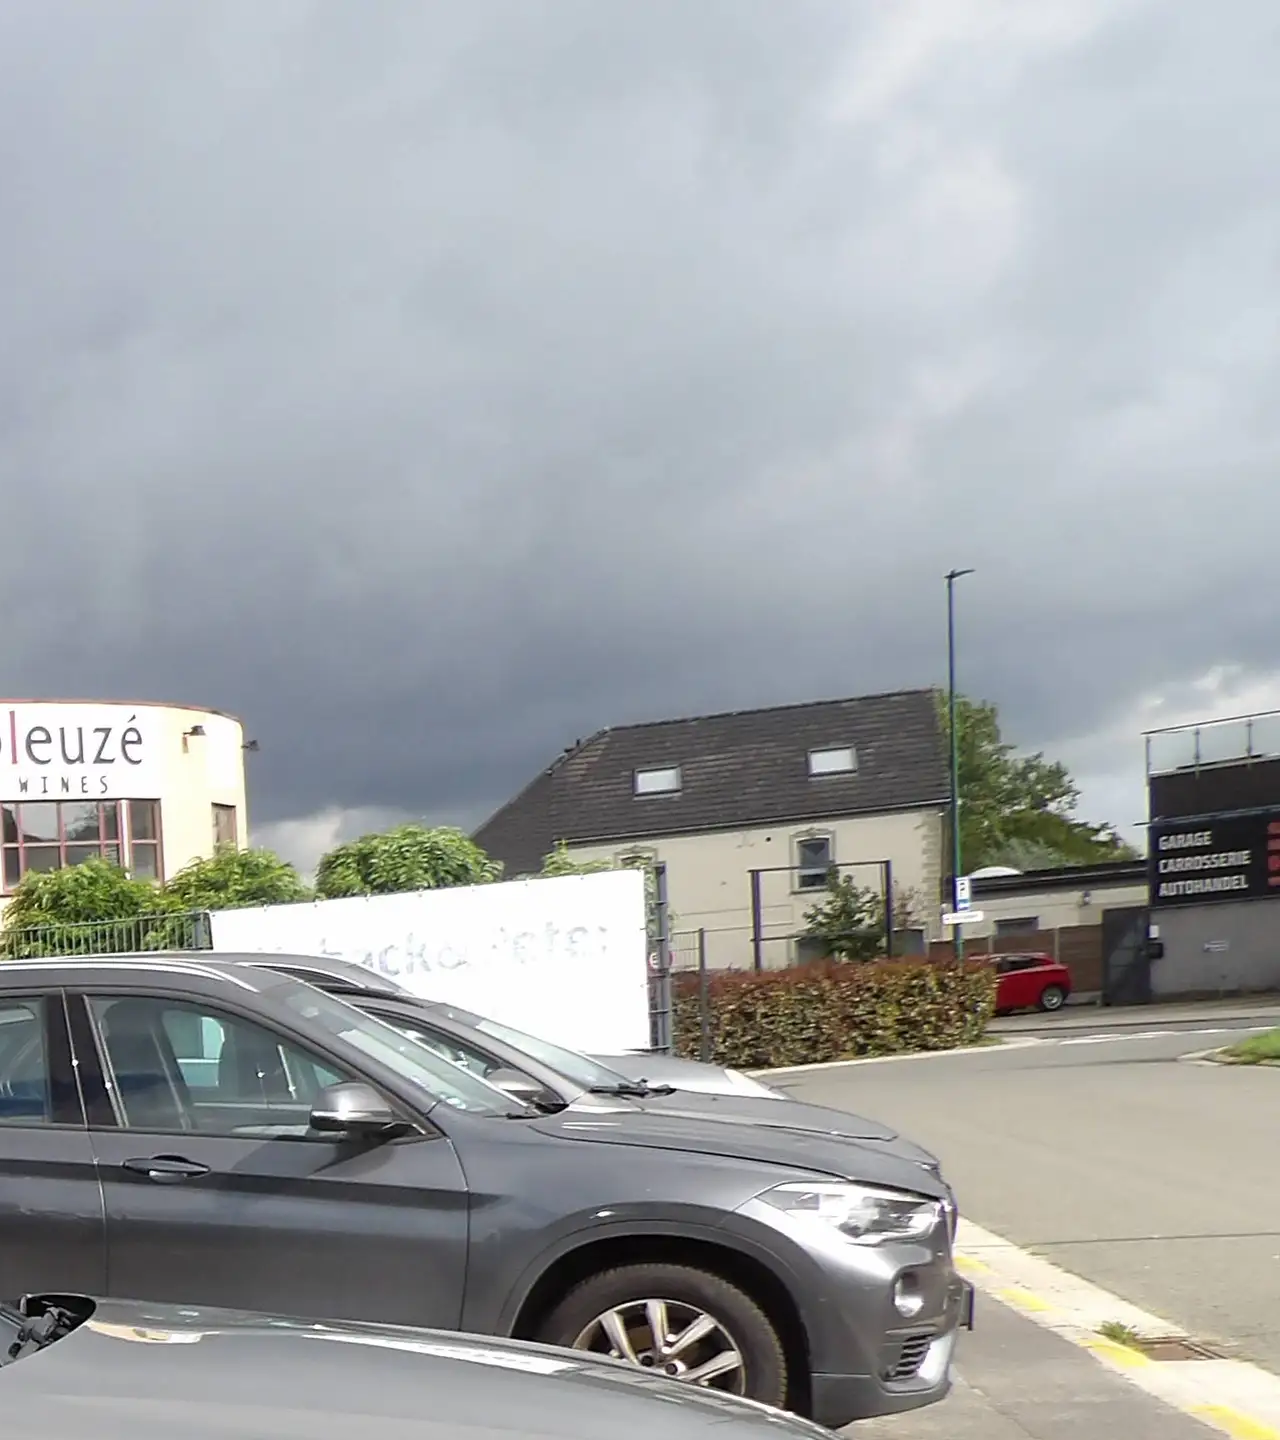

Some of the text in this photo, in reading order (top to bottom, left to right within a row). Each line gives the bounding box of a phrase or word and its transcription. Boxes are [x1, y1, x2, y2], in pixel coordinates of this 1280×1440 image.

[18, 775, 109, 794] WINES
[1159, 831, 1213, 850] GARAGE
[1159, 850, 1252, 873] CARROSSERIE
[1159, 874, 1249, 897] AUTOHANDEL
